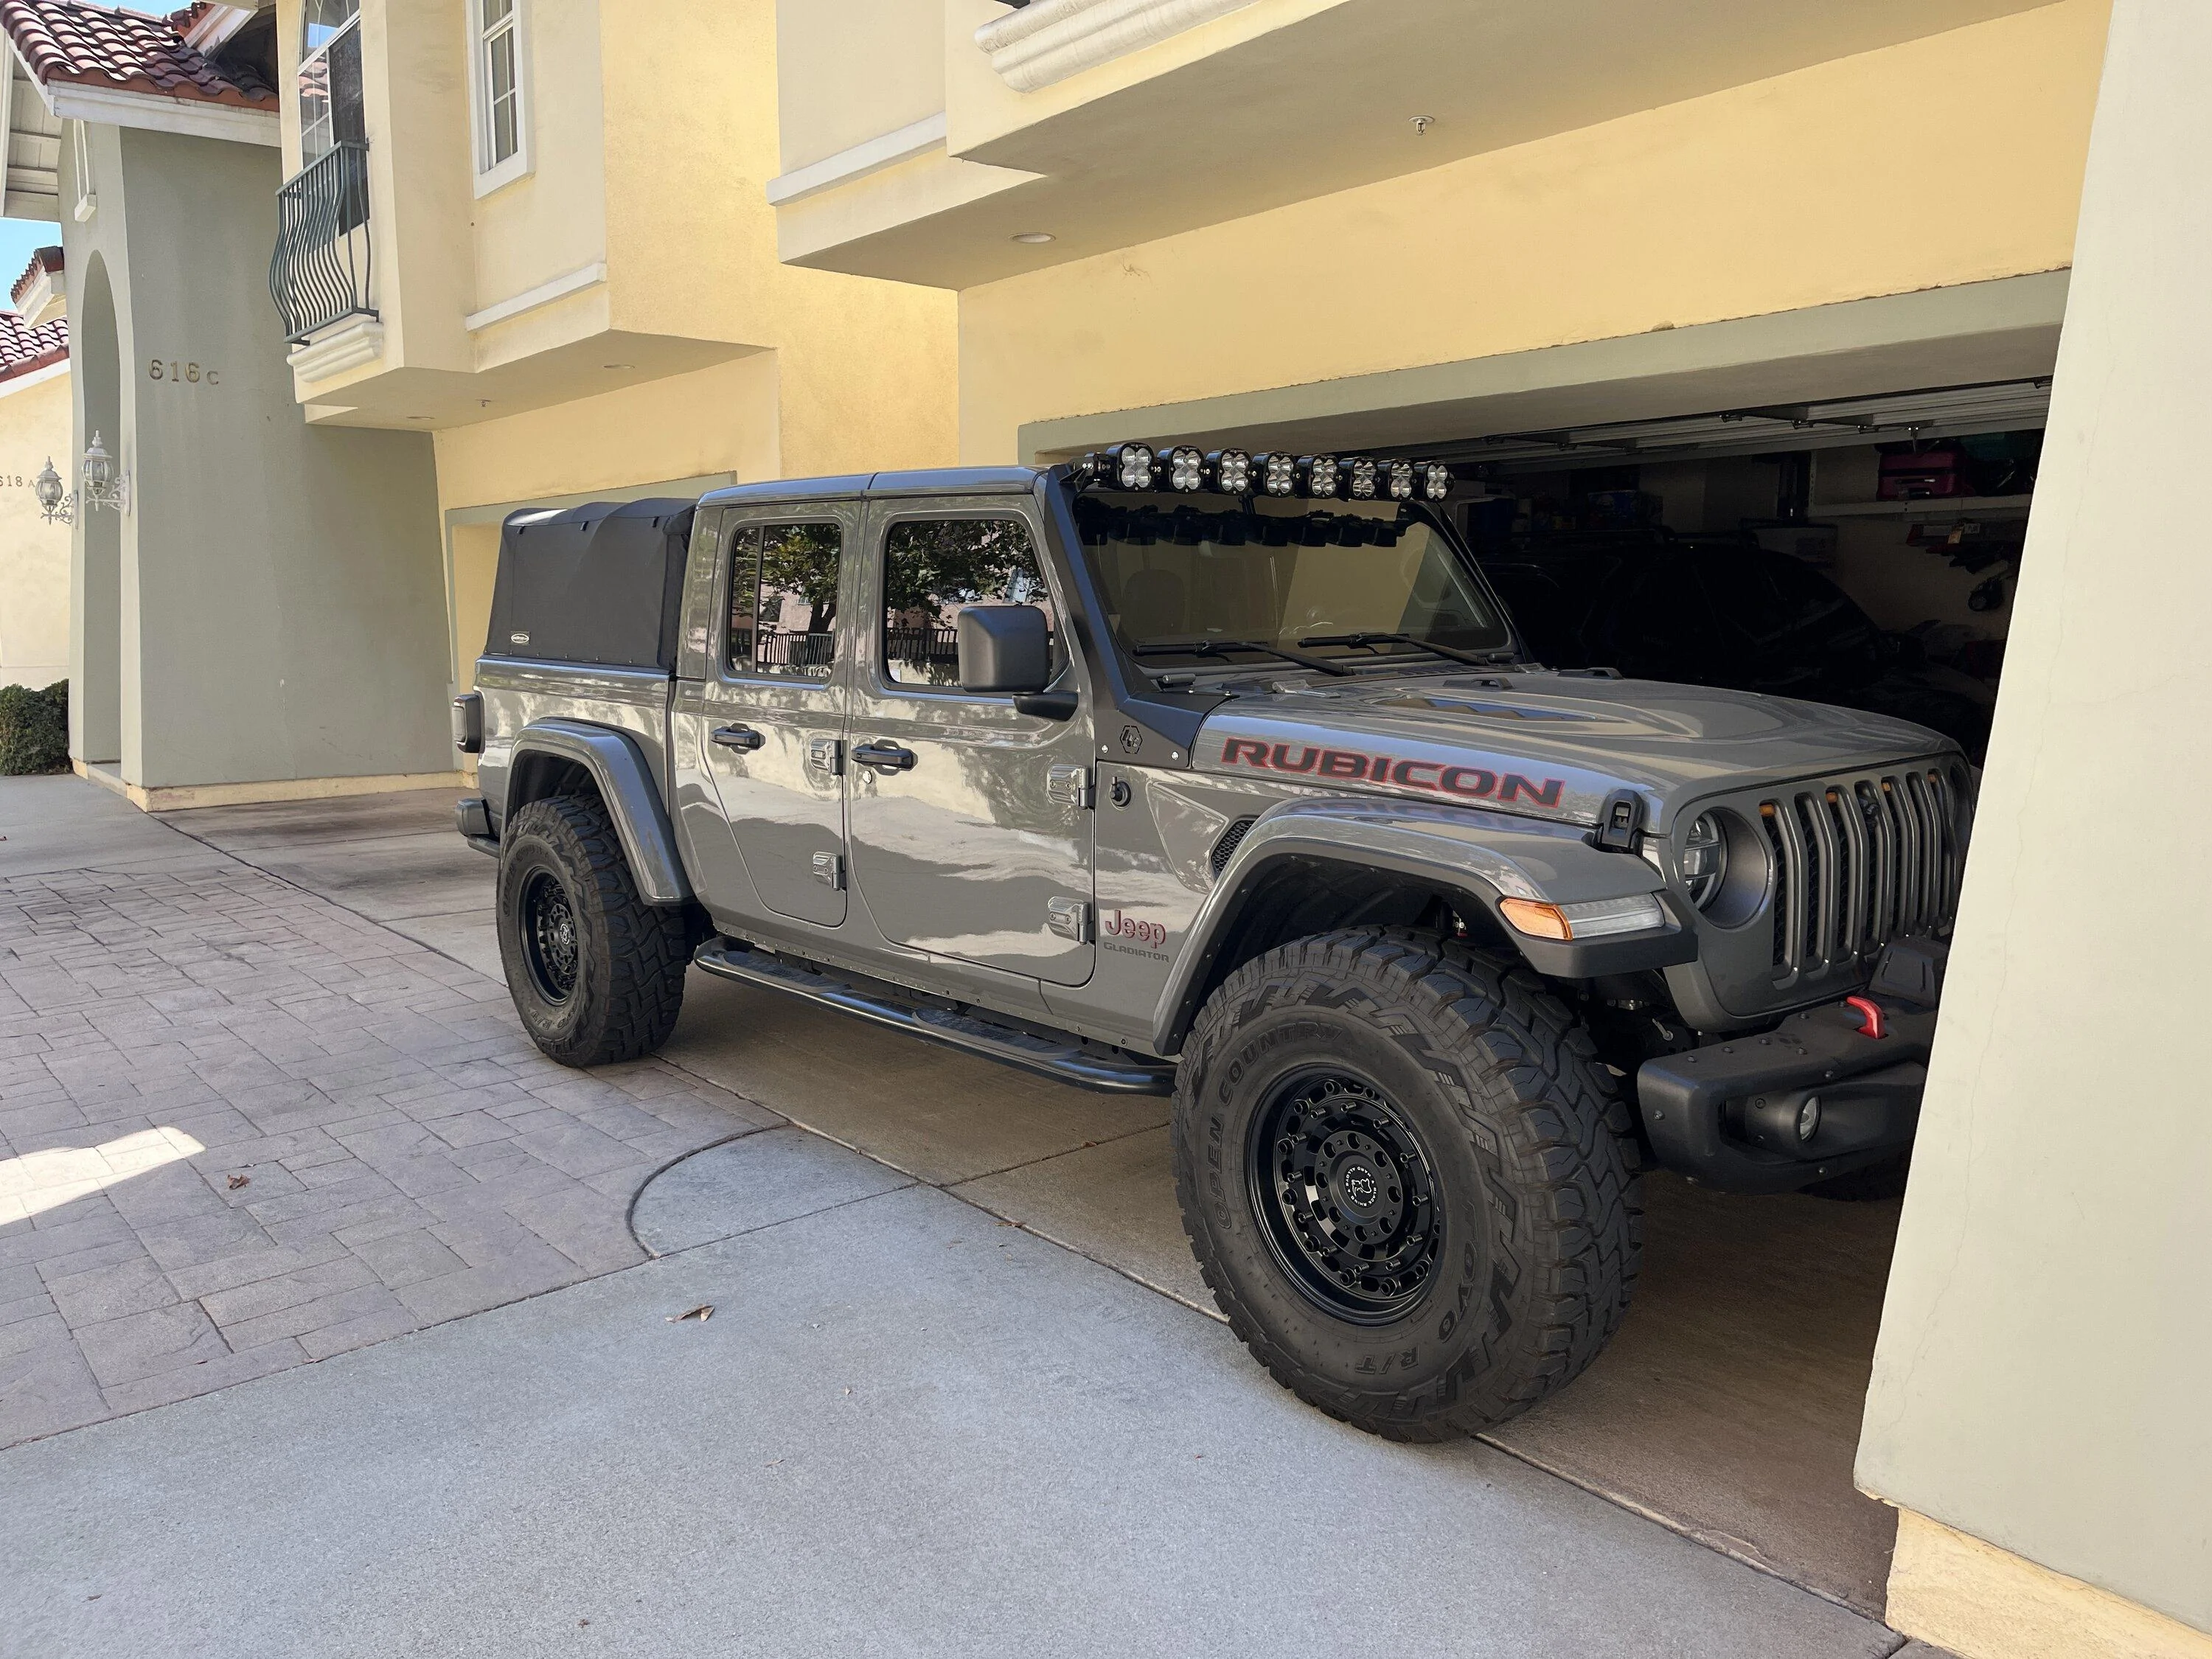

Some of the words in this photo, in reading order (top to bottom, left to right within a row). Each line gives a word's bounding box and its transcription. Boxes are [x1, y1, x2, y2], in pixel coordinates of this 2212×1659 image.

[1221, 737, 1566, 808] RUBICON
[1103, 942, 1170, 963] GLADIATOR
[1105, 910, 1166, 949] Jeep
[1218, 1021, 1344, 1105] COUNTRY
[1206, 1113, 1232, 1229] OPEN
[1354, 1343, 1421, 1375] R/T
